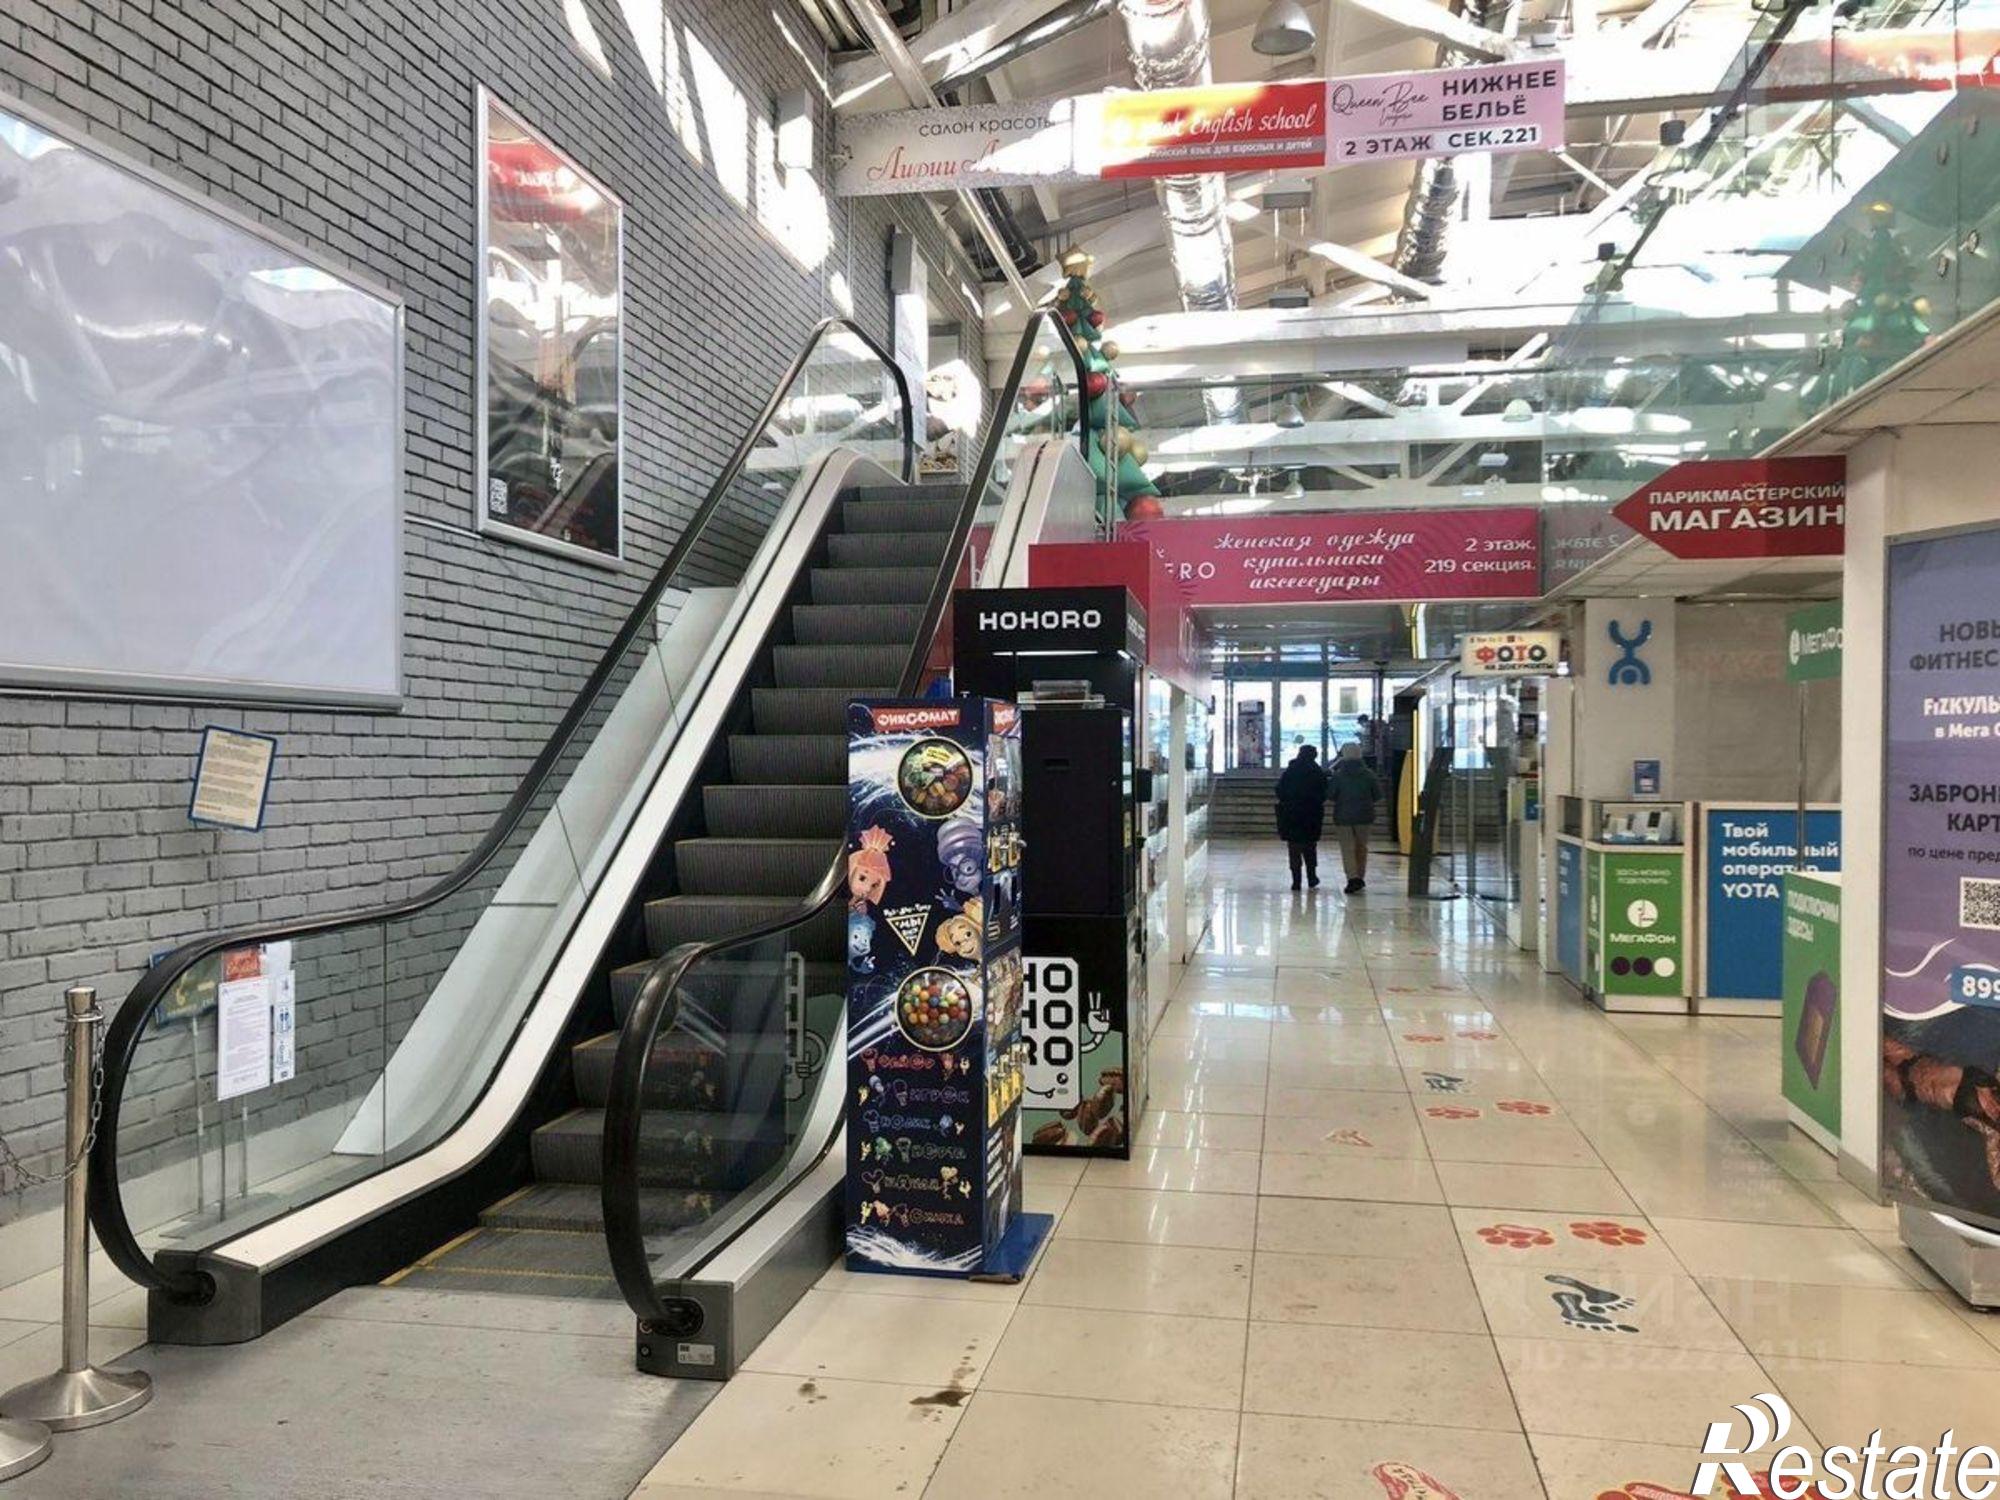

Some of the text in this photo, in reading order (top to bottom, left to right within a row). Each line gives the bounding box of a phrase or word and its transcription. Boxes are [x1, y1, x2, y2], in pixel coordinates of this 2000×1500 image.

[1442, 70, 1557, 96] НИЖНЕЕ
[1442, 95, 1527, 122] БЕЛЬЁ
[919, 120, 974, 137] салон
[1190, 107, 1255, 144] English
[1259, 102, 1318, 130] school
[1345, 127, 1538, 156] 2 ЭТАЖ СЕК.221
[1649, 482, 1845, 505] ПАРИКМАСТЕРСКИЙ
[1650, 505, 1844, 532] МАГАЗИН
[1214, 528, 1416, 551] женская одежда
[1465, 537, 1536, 552] 2 этаж.
[1243, 554, 1385, 575] купальники
[1425, 559, 1536, 574] 219 секция.
[1249, 575, 1381, 595] аксессуары
[979, 609, 1102, 631] HOHORO
[1475, 644, 1548, 663] ФОТО
[1909, 648, 1999, 672] ФИТНЕС
[1935, 726, 1945, 738] в
[1948, 723, 1990, 738] Мега
[1909, 783, 2000, 804] ЗАБРОН
[1722, 821, 1769, 838] Твой
[1947, 813, 2000, 833] КАРТ
[1908, 847, 1926, 859] по
[1929, 848, 1965, 859] цене
[1722, 863, 1820, 879] операт
[1722, 882, 1780, 898] YOTA
